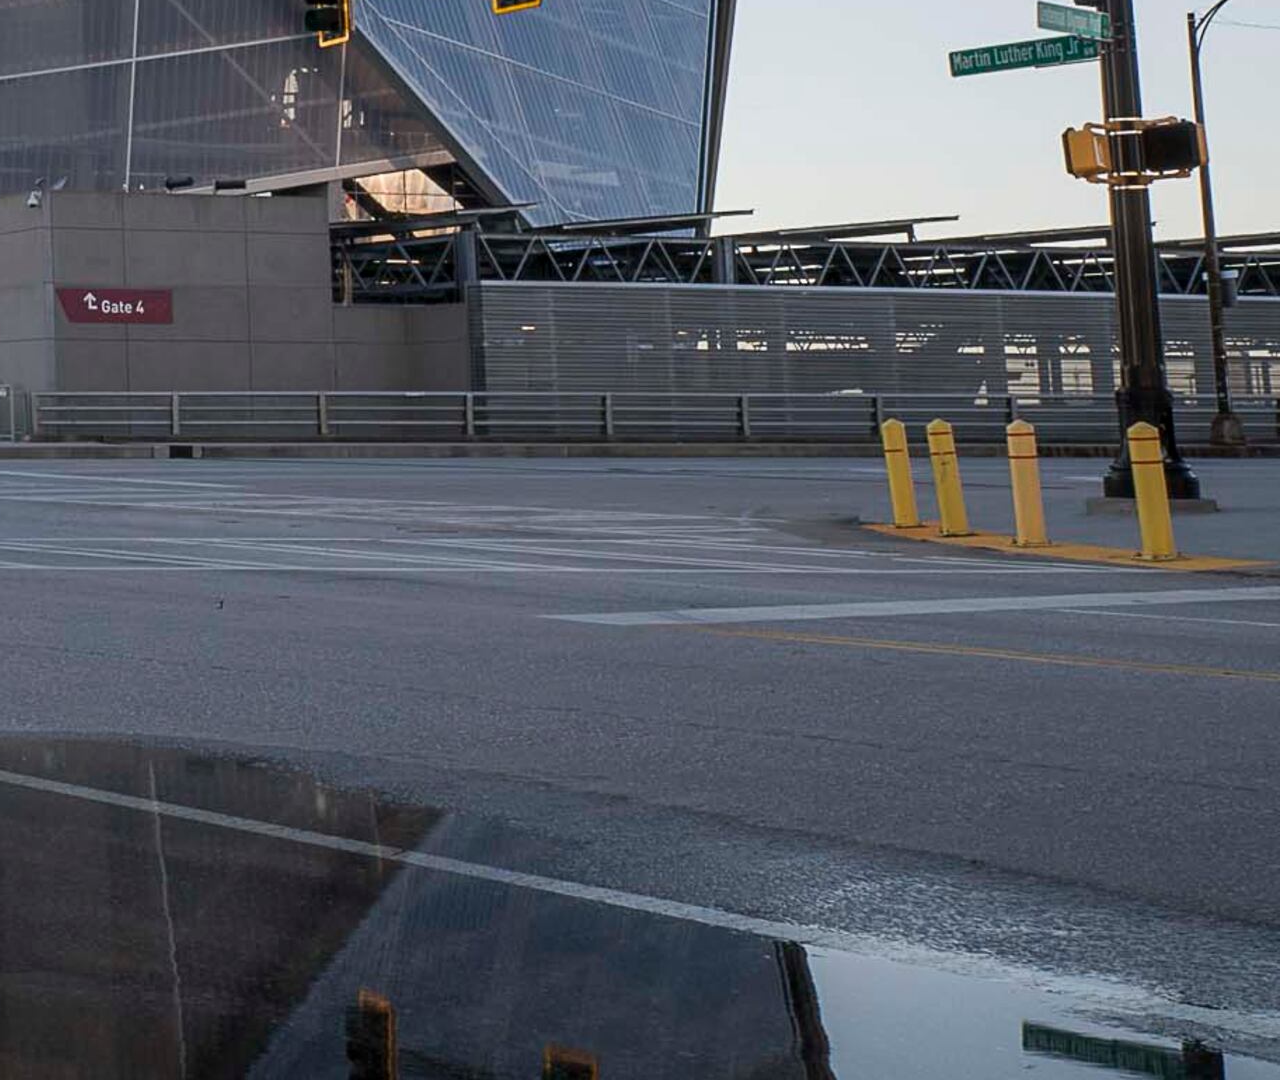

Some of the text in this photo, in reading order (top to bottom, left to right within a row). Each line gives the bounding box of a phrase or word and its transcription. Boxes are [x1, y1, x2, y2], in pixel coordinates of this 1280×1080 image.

[953, 37, 1079, 70] Martin Luther King Jr
[101, 300, 144, 314] Gate 4
